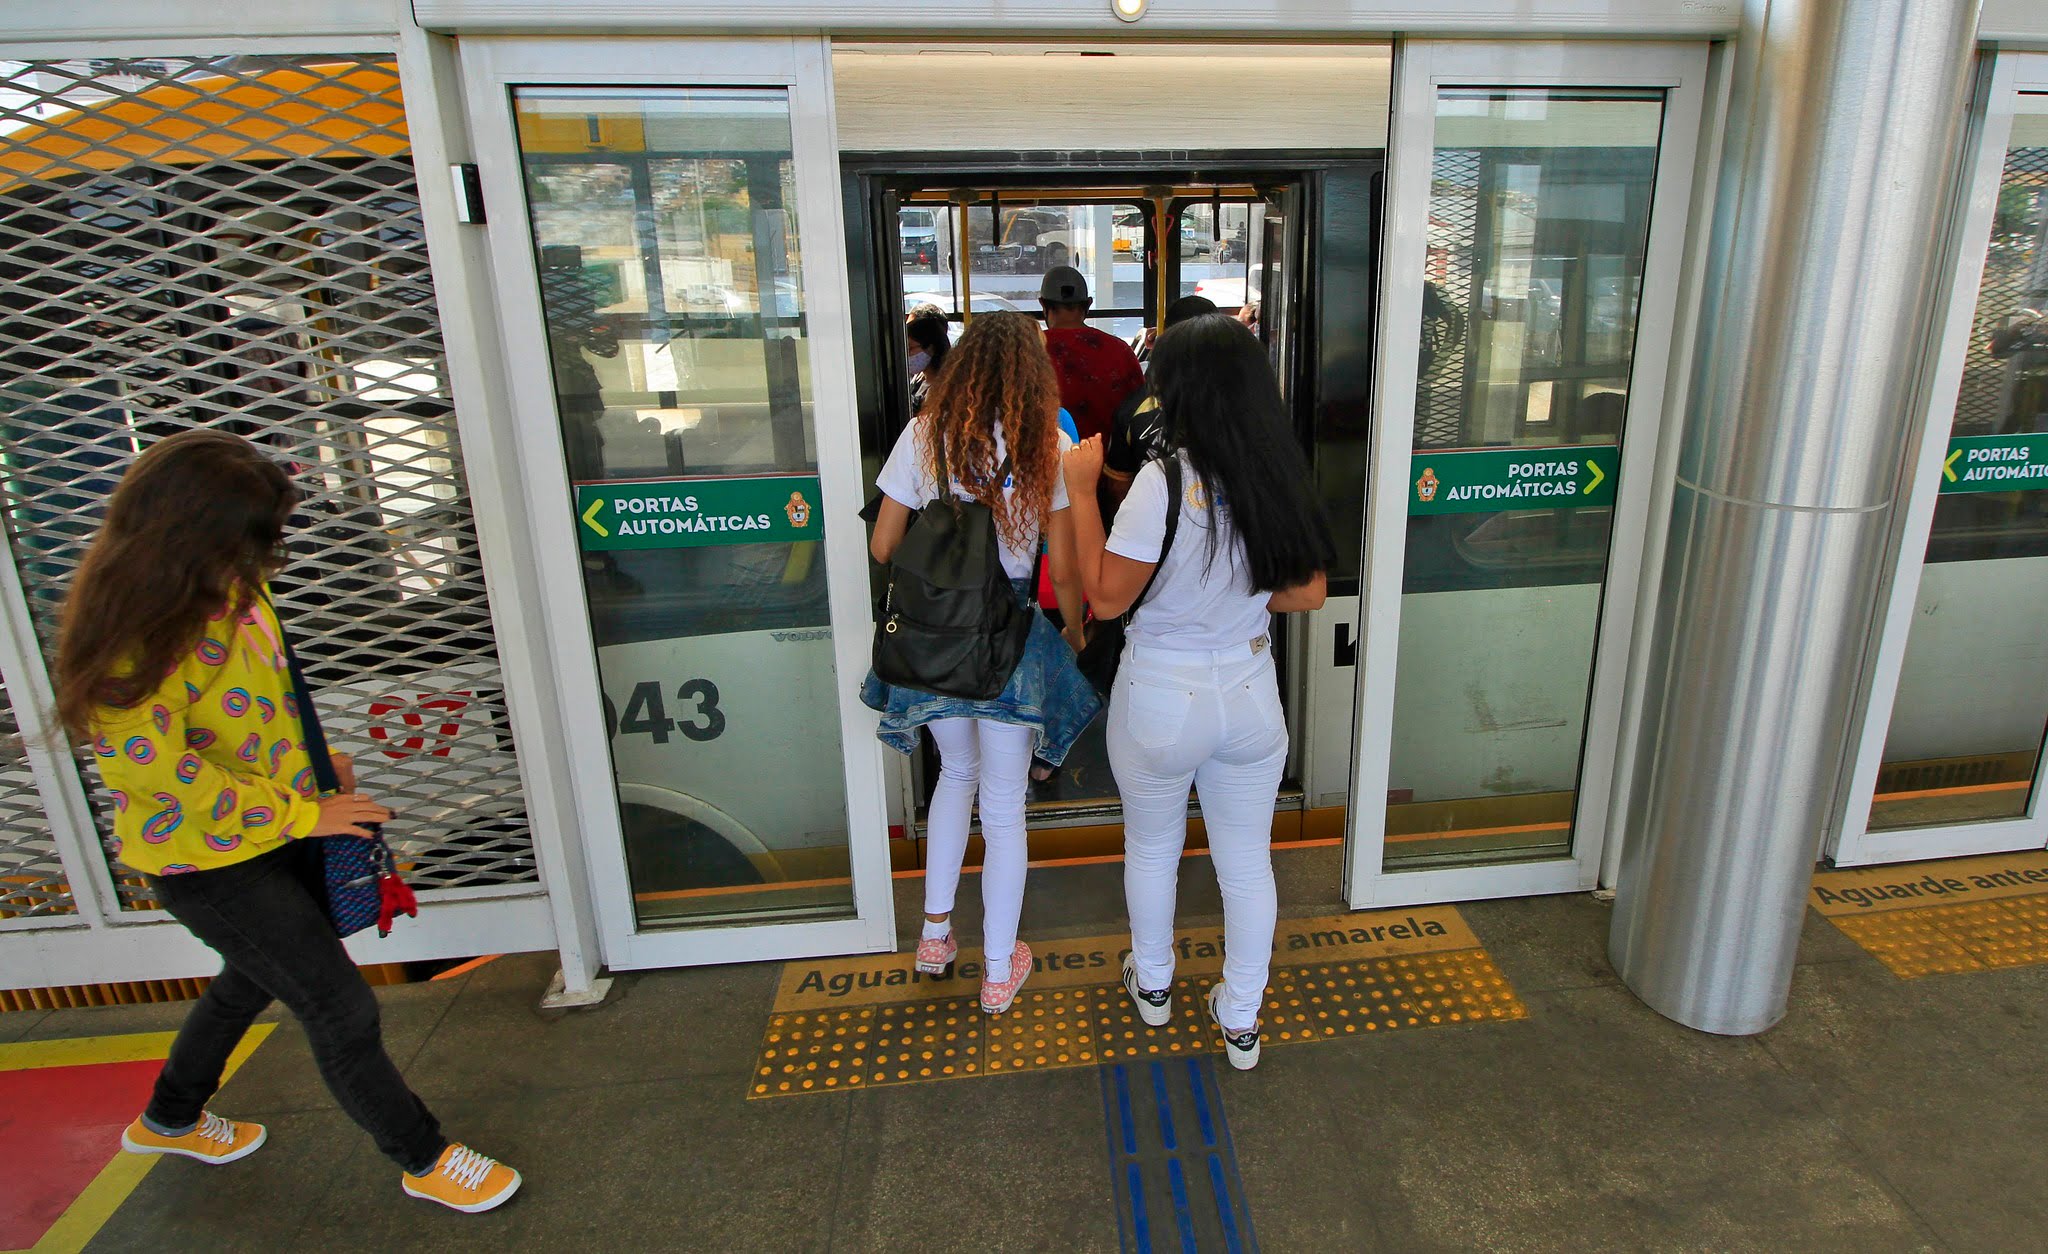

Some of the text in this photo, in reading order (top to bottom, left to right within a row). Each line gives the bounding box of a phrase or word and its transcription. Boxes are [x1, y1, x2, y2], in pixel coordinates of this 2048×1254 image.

[1967, 446, 2030, 463] PORTAS
[1508, 461, 1579, 478] PORTAS
[1446, 479, 1577, 501] AUTOMÁTICAS
[614, 496, 699, 514] PORTAS
[618, 512, 771, 536] AUTOMÁTICAS
[604, 678, 726, 744] 43
[1812, 875, 1970, 908] Aguarde
[1031, 950, 1107, 974] ntes
[1288, 917, 1448, 950] amarela
